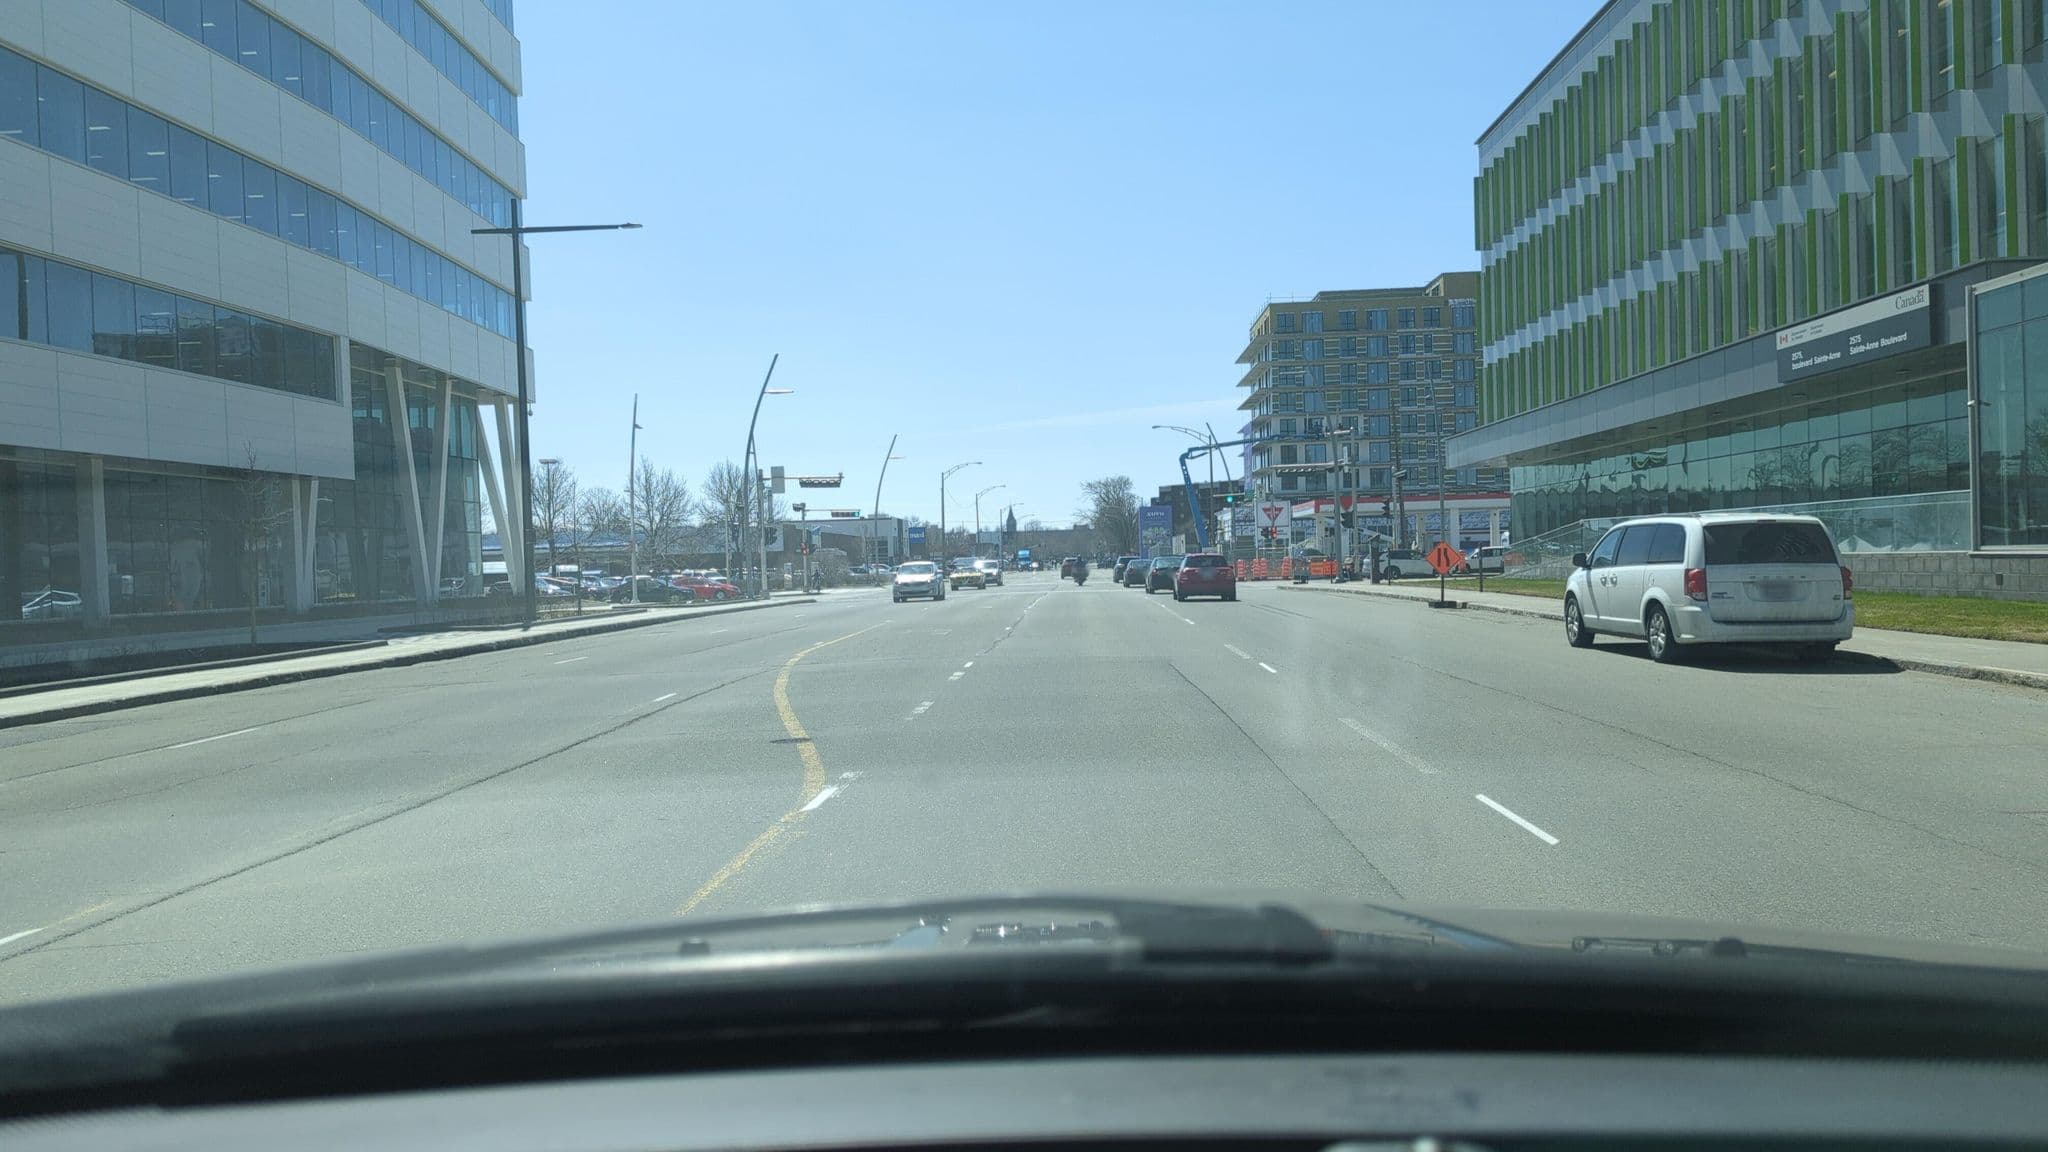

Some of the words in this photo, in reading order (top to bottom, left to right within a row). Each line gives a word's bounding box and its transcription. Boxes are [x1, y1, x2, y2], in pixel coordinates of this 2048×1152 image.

[1895, 291, 1925, 310] Canada
[1849, 334, 1862, 345] 2575
[1849, 341, 1879, 355] Sainte-Anne
[1880, 331, 1907, 347] Boulevard
[1791, 358, 1814, 370] boulevard
[1814, 352, 1841, 364] Sainte-Anne
